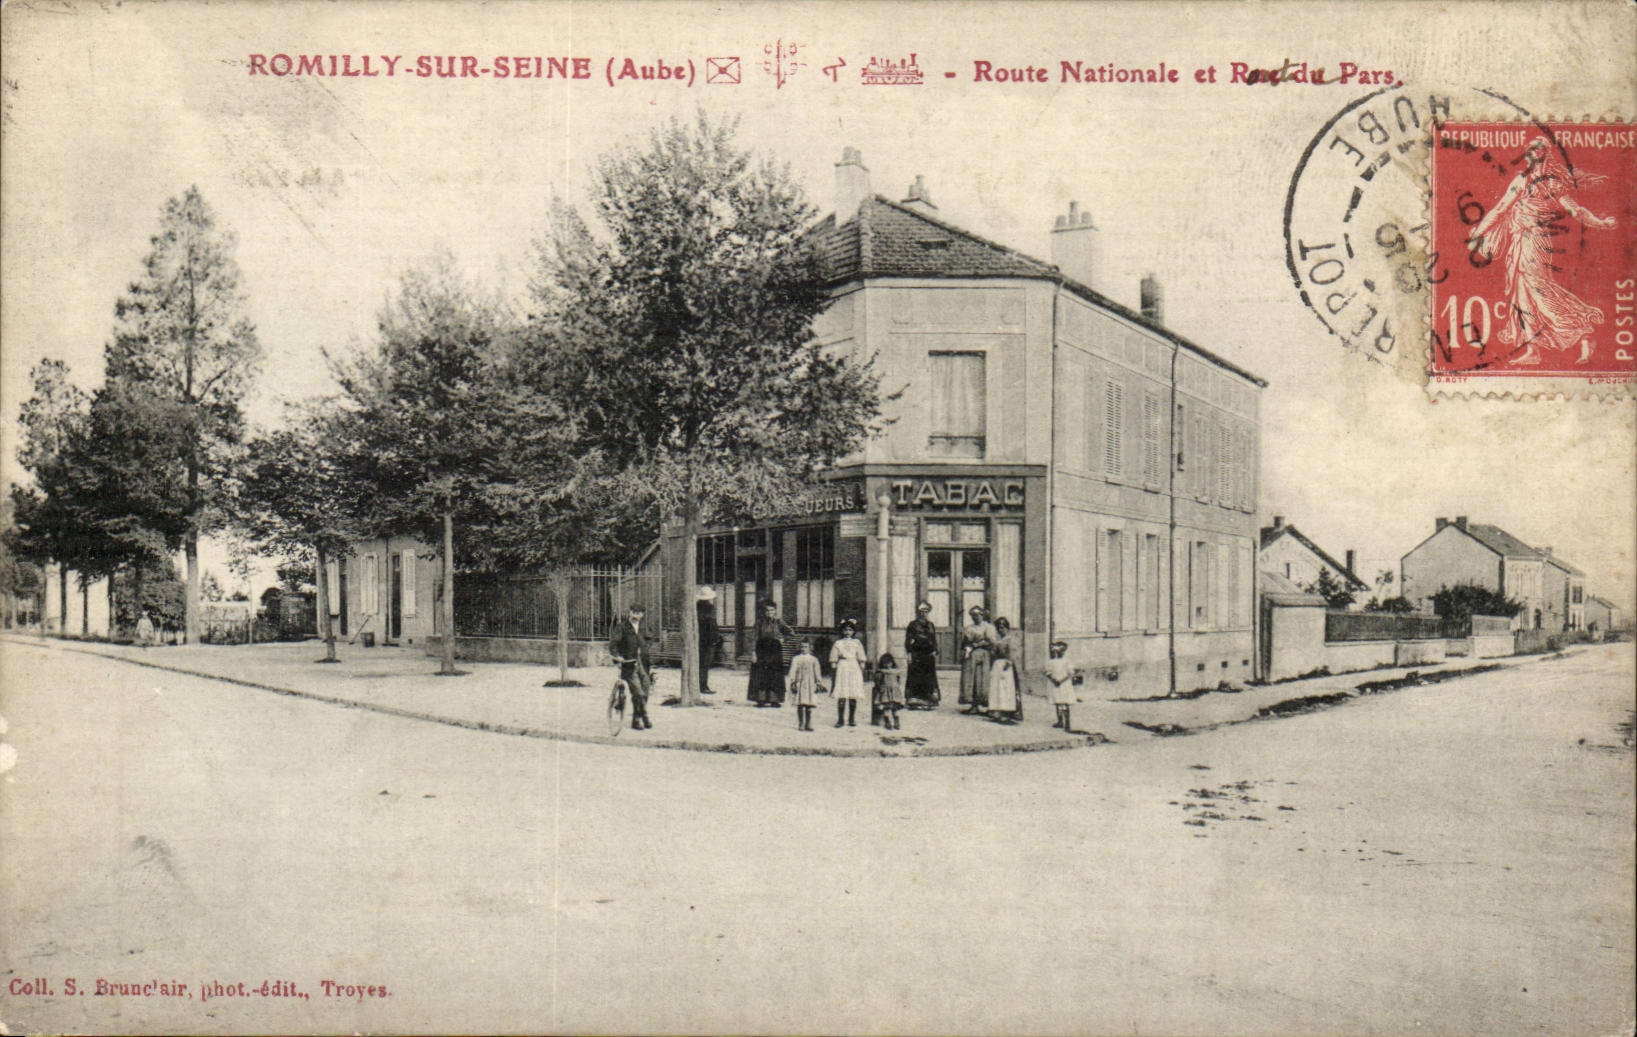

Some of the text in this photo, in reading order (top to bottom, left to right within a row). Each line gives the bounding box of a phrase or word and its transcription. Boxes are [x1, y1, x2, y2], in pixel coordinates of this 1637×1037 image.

[1554, 130, 1636, 149] FRANÇAISE
[1615, 278, 1635, 361] POSTES
[891, 480, 1025, 507] TABAC
